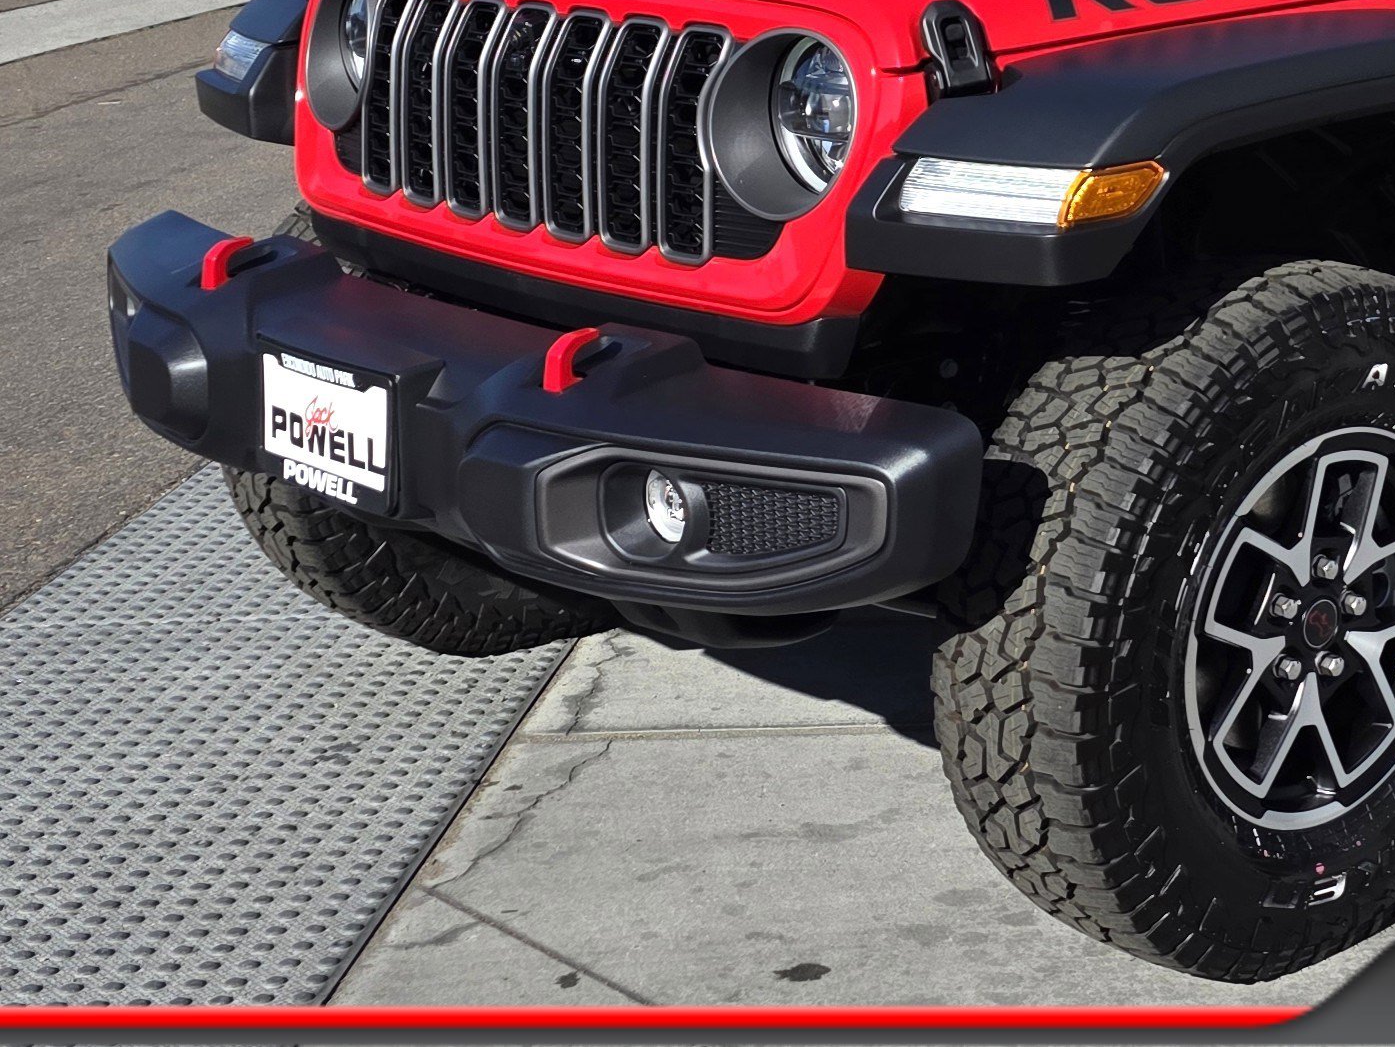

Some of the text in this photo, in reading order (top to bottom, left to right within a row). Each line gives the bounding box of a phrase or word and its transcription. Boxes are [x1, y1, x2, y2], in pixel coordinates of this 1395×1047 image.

[305, 395, 339, 439] Jack
[272, 405, 386, 477] POWELL
[283, 458, 358, 505] POWELL
